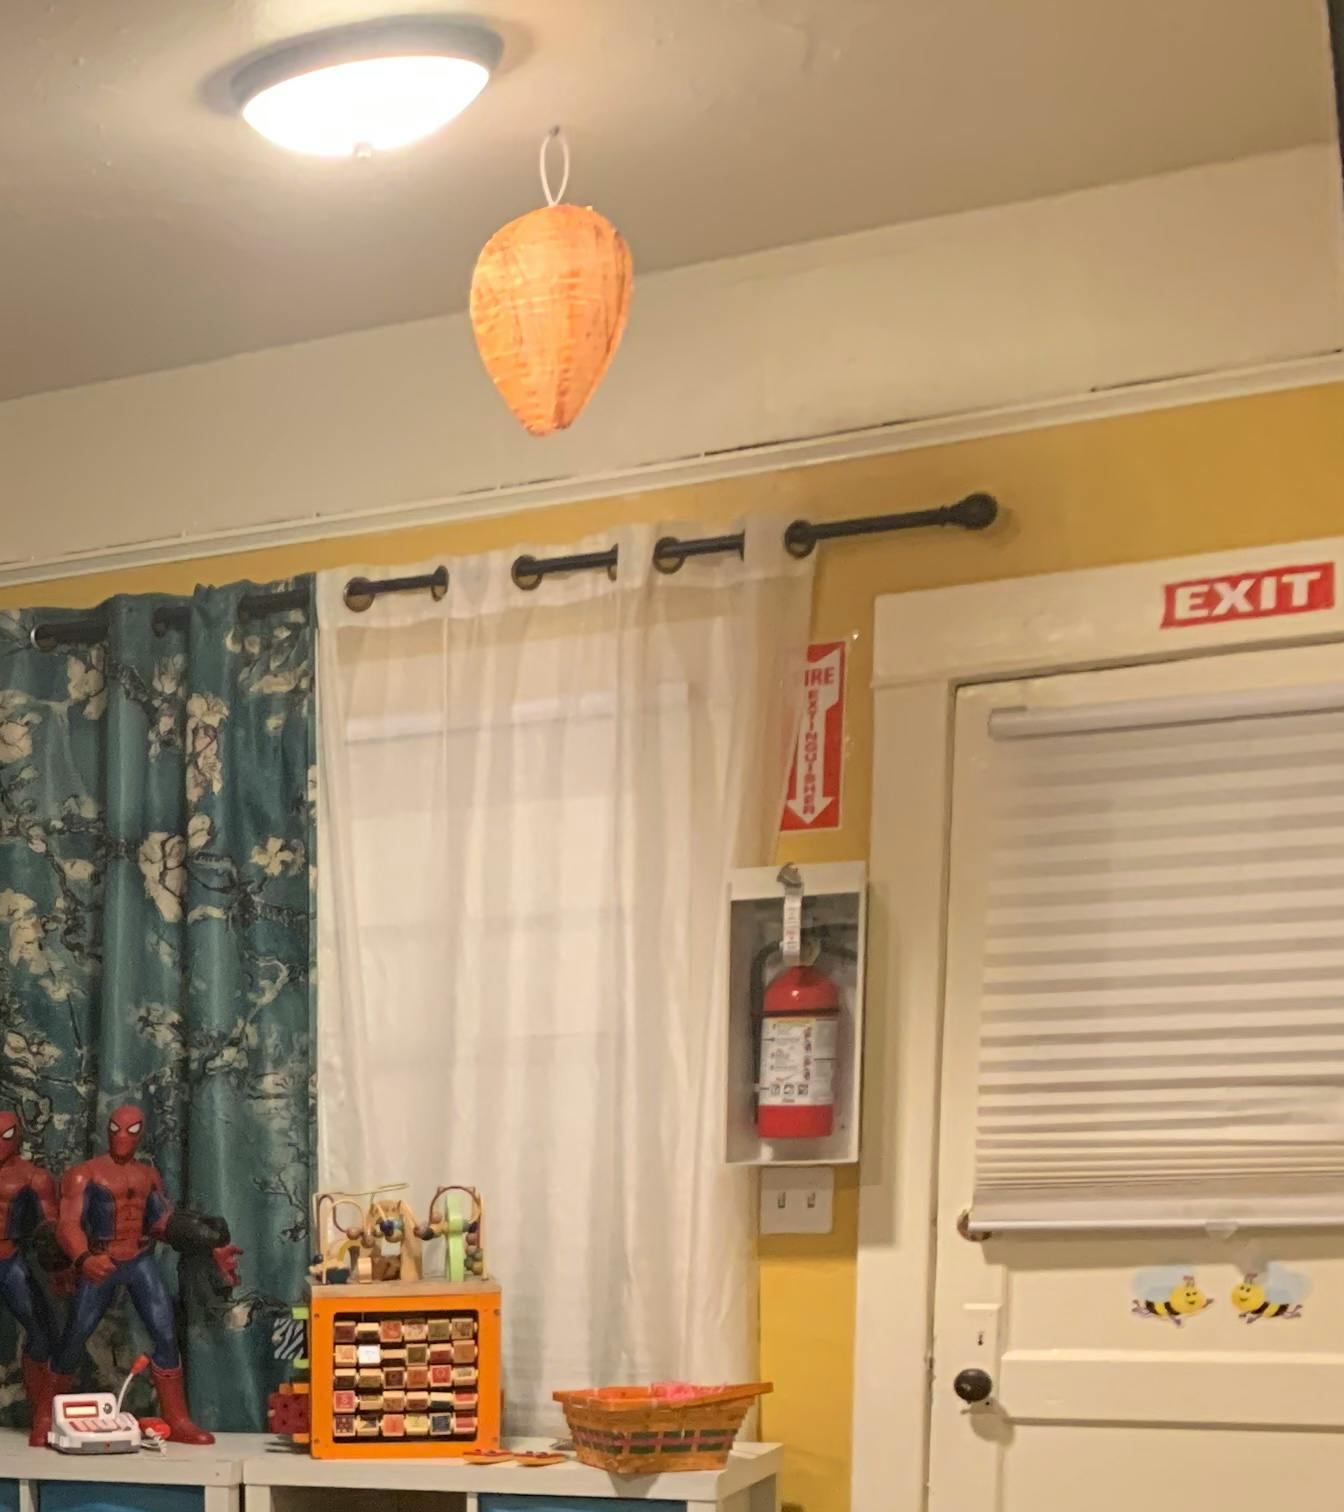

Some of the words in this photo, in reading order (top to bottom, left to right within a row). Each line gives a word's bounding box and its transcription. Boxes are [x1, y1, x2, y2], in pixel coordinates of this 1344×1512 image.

[1175, 571, 1322, 620] EXIT
[804, 666, 834, 686] IRE
[803, 690, 818, 815] EXTINGUISHER
